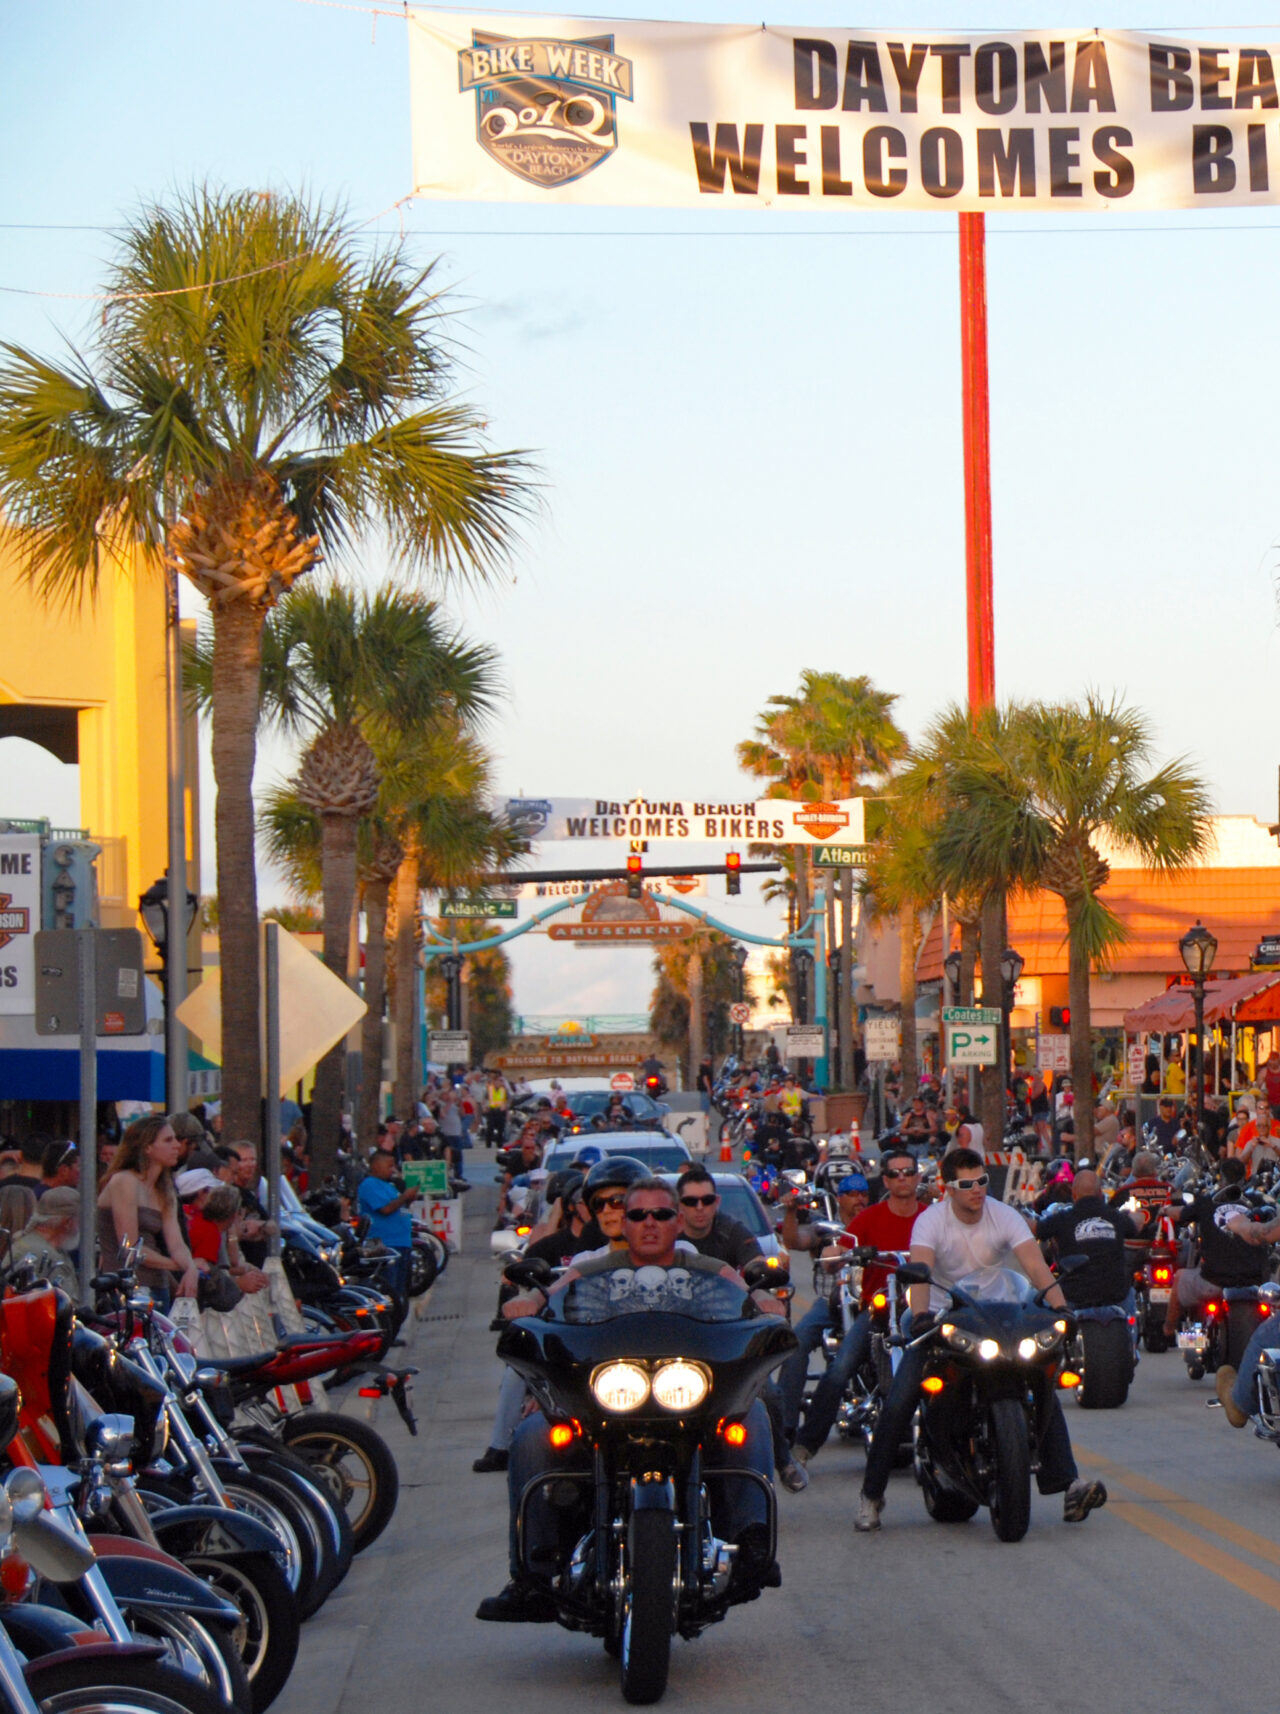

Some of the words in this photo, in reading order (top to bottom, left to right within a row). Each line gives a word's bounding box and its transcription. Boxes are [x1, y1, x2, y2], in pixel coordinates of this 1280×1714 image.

[471, 45, 534, 80] BIKE
[545, 46, 623, 89] WEEK
[793, 37, 1117, 115] DAYTONA
[512, 150, 585, 166] DAYTONA
[689, 121, 1135, 199] WELCOMES
[529, 163, 569, 176] BEACH
[567, 817, 689, 838] WELCOMES
[705, 818, 785, 838] BIKERS
[555, 924, 684, 937] AMUSEMENT
[948, 1008, 982, 1021] Coates
[868, 1021, 897, 1029] YIELD
